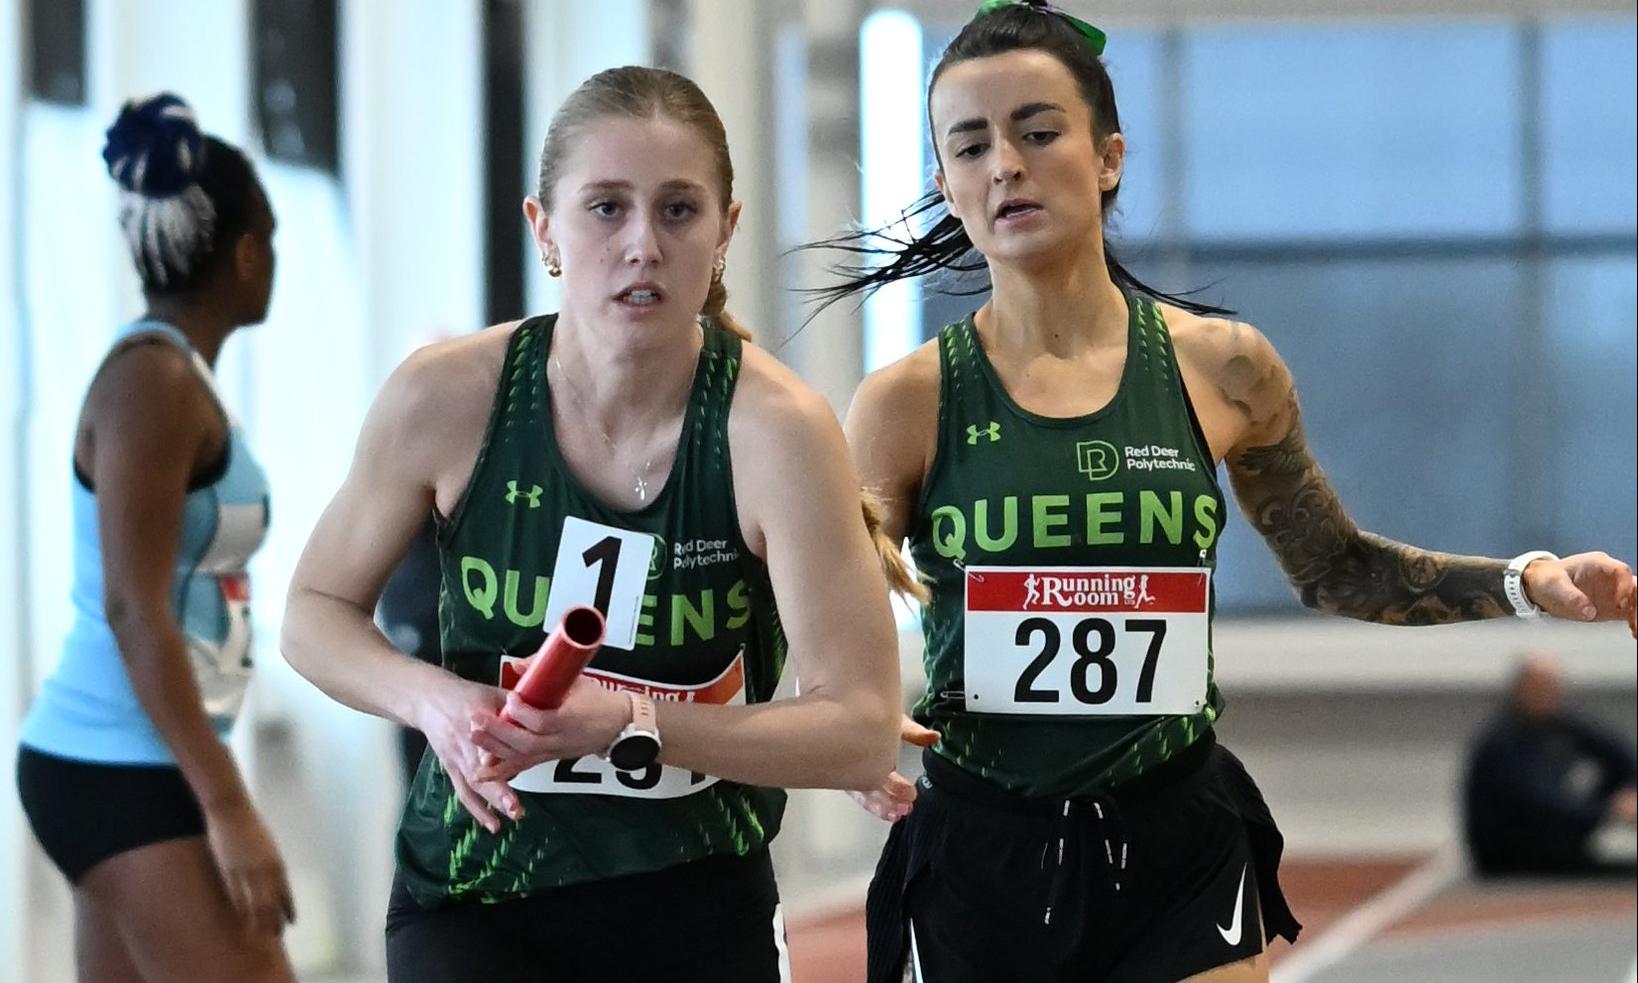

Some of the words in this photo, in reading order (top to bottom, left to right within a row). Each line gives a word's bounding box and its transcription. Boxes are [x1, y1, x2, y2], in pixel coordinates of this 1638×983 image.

[1125, 446, 1149, 458] Red
[1150, 446, 1179, 458] Deer
[1127, 458, 1196, 472] Polytechnic
[696, 539, 727, 552] Deer
[932, 491, 1218, 561] QUEENS
[461, 556, 751, 646] QUENS
[582, 536, 622, 616] 1
[1041, 574, 1136, 606] Running
[1014, 617, 1167, 705] 287
